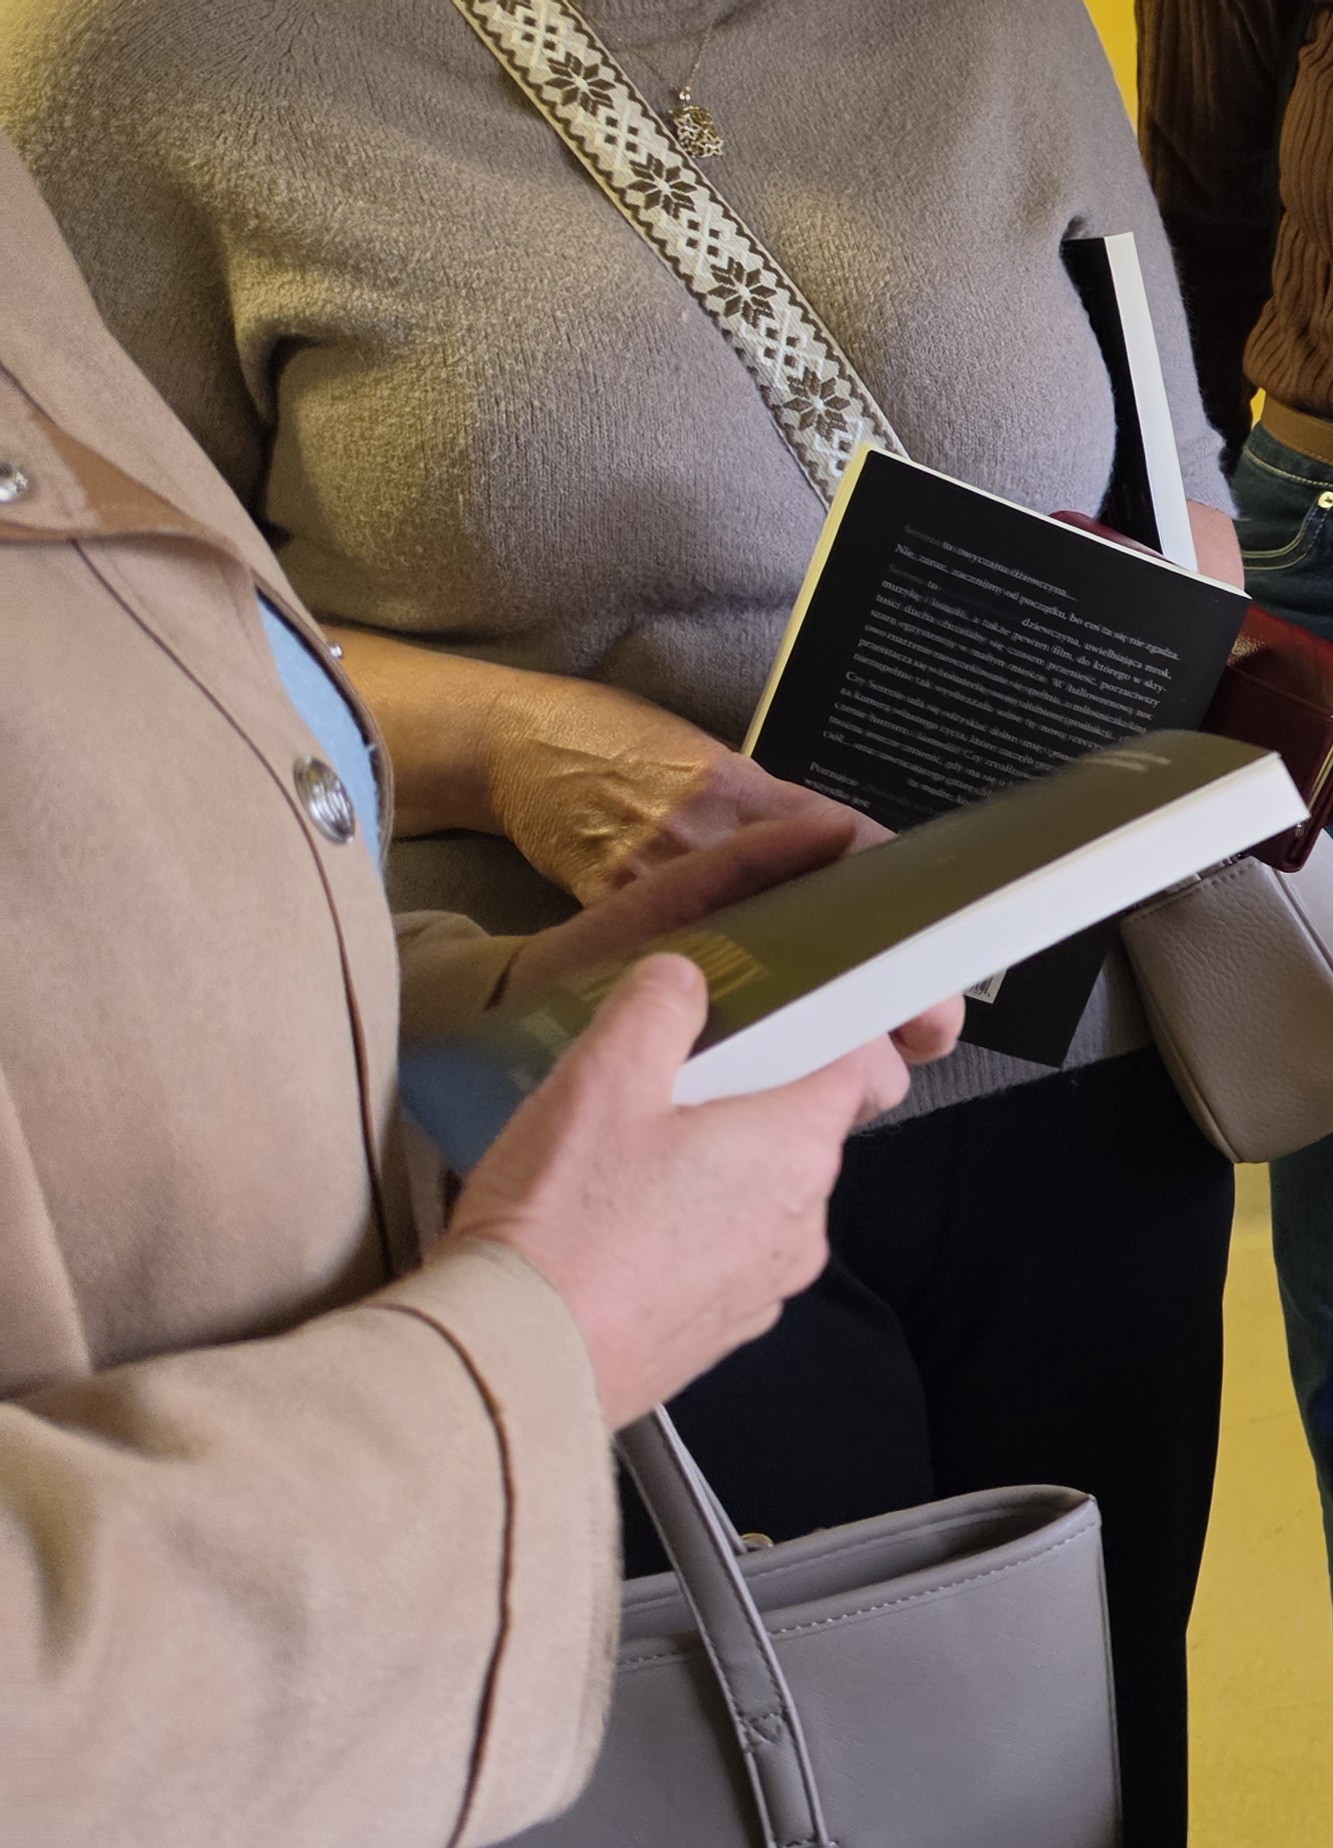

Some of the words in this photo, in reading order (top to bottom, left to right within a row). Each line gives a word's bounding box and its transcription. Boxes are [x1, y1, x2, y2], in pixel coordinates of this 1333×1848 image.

[1020, 617, 1082, 649] dziewczyna,
[1084, 640, 1143, 672] uwielbiająca
[1144, 661, 1173, 680] mrok,
[1091, 660, 1131, 683] którego
[1099, 679, 1159, 711] porzuciwszy
